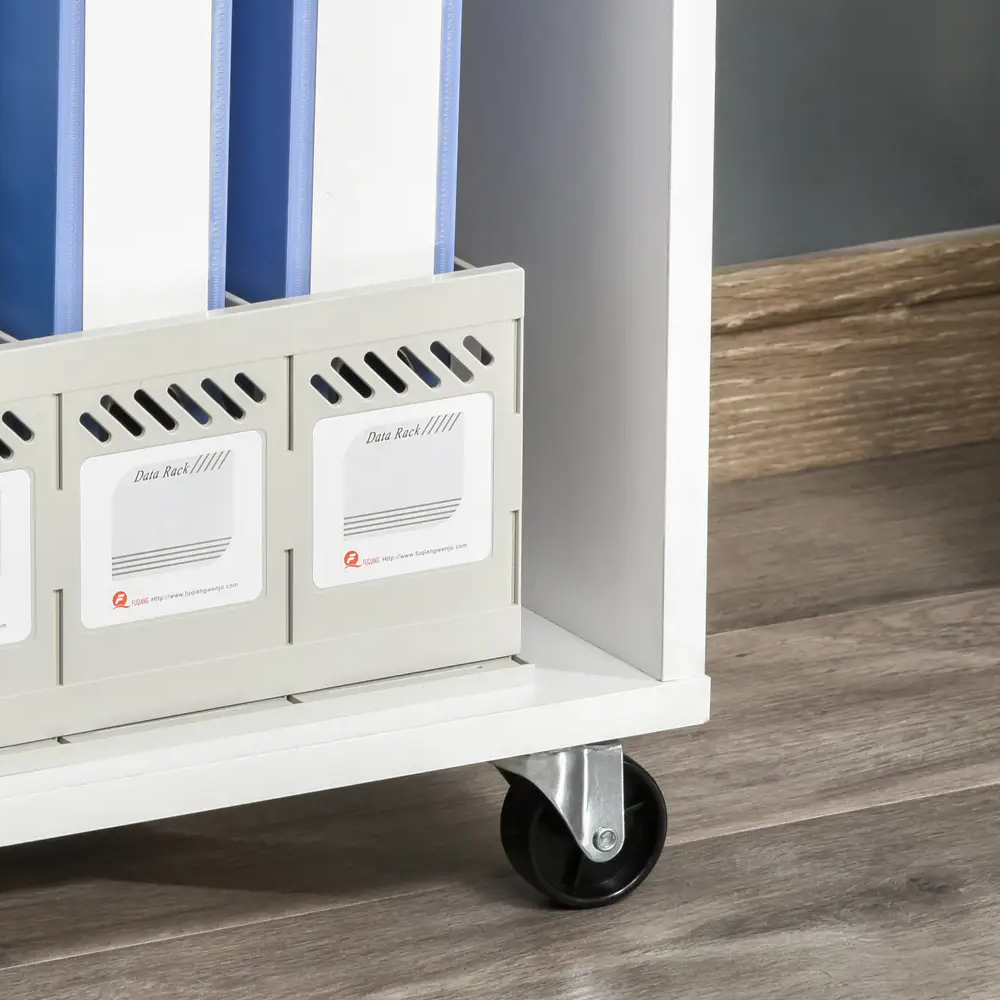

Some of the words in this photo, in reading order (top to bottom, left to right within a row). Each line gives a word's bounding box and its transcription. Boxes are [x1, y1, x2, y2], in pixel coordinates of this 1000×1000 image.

[366, 430, 391, 444] Data
[394, 423, 421, 440] Rack
[134, 468, 159, 483] Data
[162, 461, 190, 479] Rack
